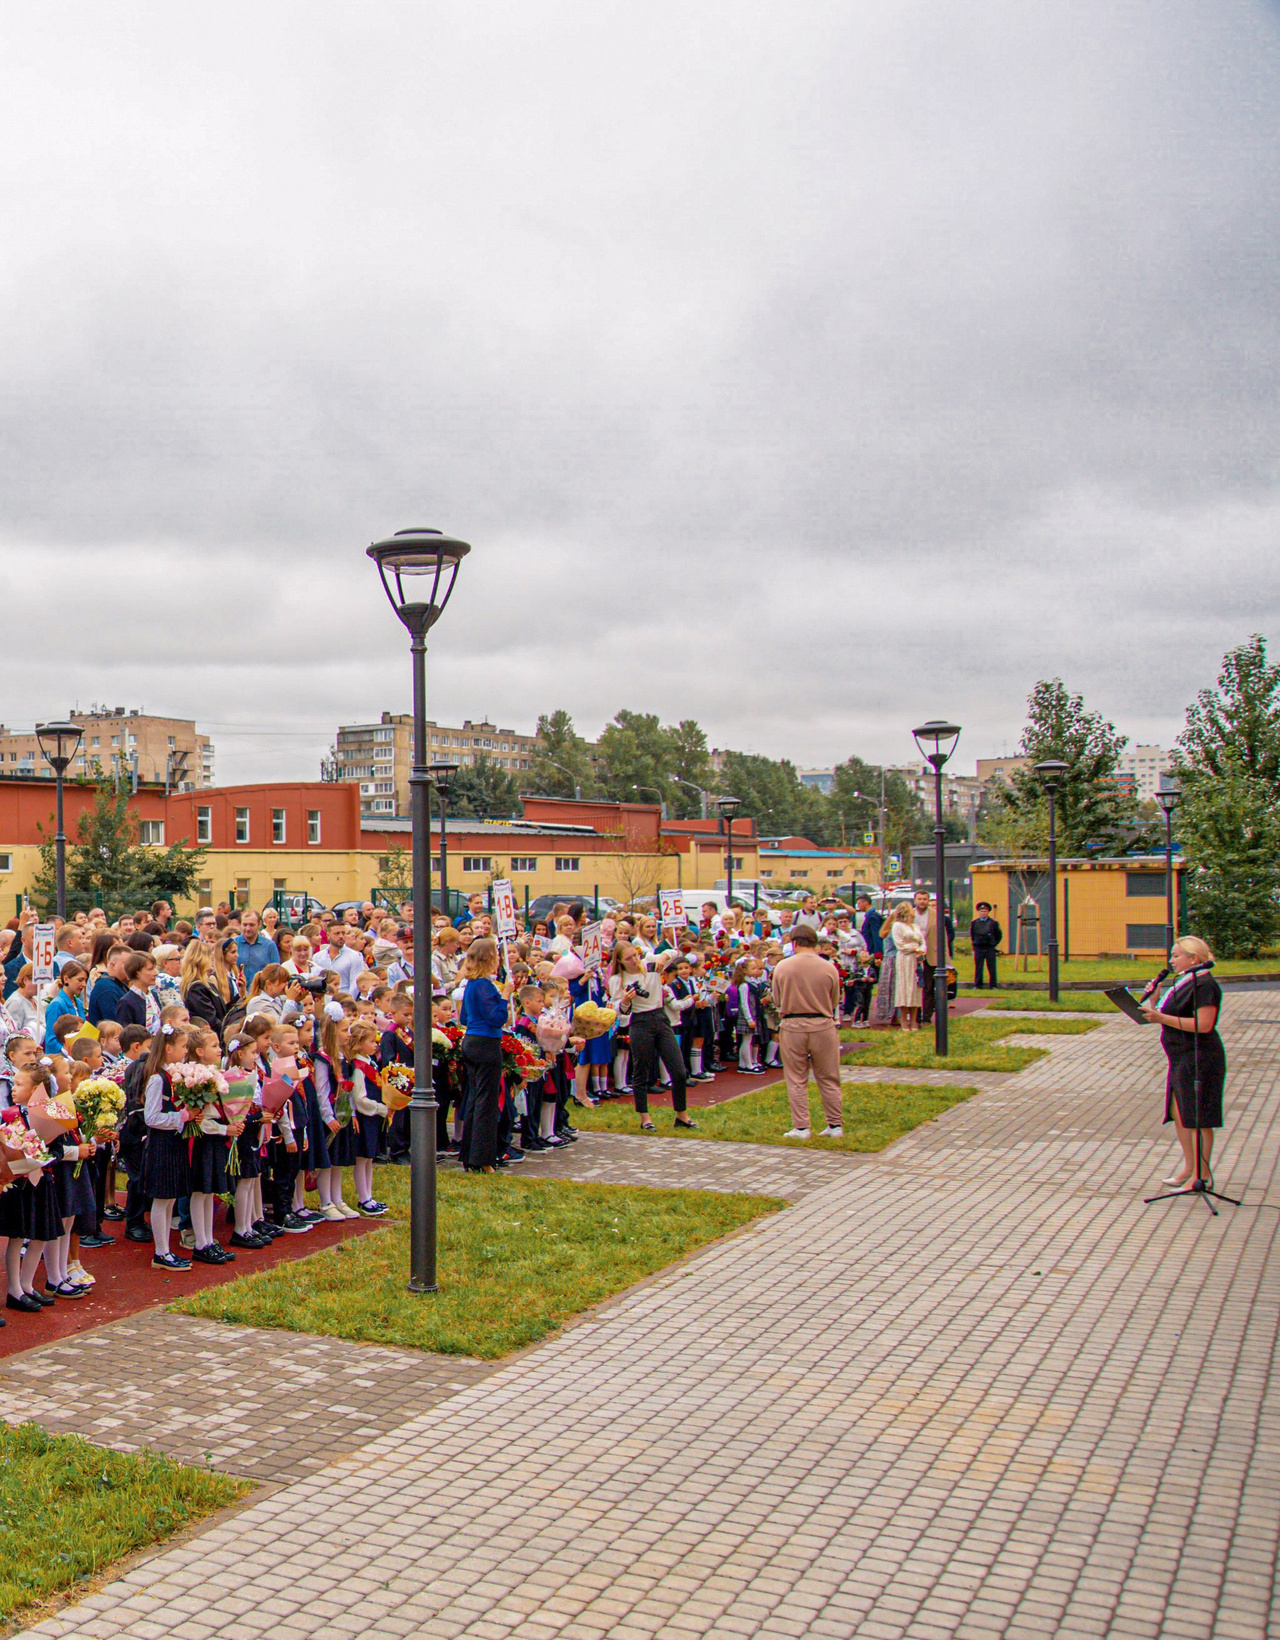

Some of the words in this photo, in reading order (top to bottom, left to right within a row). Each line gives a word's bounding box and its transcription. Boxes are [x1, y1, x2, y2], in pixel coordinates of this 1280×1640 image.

[497, 895, 512, 920] 1-В
[662, 899, 683, 916] 2-Б
[35, 941, 52, 966] 1-Б
[583, 934, 600, 958] 2-А
